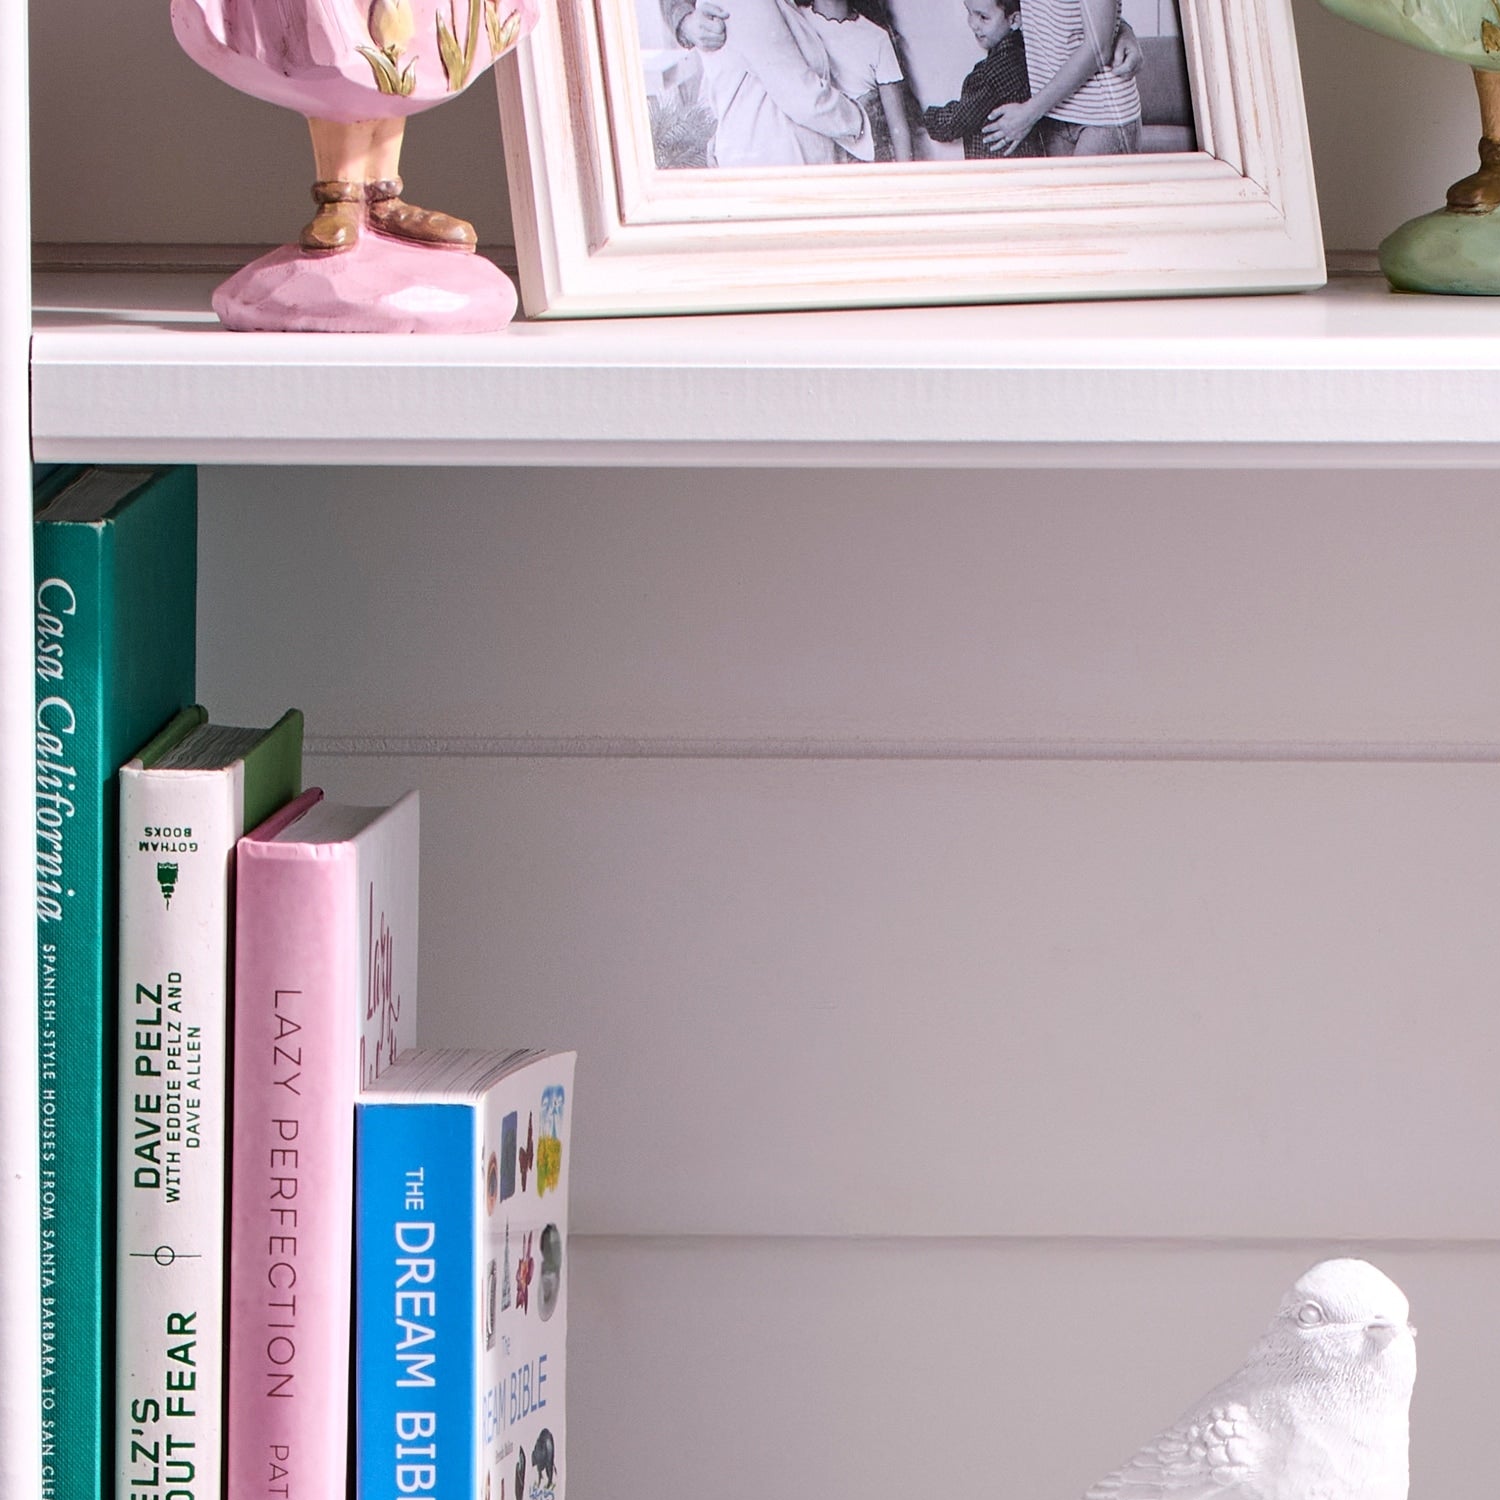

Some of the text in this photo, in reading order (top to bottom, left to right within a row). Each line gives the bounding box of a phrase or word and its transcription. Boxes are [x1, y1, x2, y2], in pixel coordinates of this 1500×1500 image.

[36, 578, 77, 923] Casa California
[139, 842, 198, 852] GOTHAM
[144, 827, 192, 838] BOOKS
[43, 944, 56, 1079] SPANISH-STYLE
[134, 983, 162, 1188] DAVE PELZ
[166, 972, 181, 1203] WITH EDDIE PELZ AND
[186, 1026, 201, 1148] DAVE ALLEN
[43, 1090, 56, 1161] HOUSES
[42, 1170, 56, 1220] FROM
[266, 990, 302, 1398] LAZY PERFECTION
[405, 1167, 424, 1210] THE
[42, 1230, 56, 1288] SANTA
[42, 1299, 56, 1378] BARBARA
[395, 1222, 436, 1387] DREAM
[42, 1387, 56, 1410] TO
[166, 1311, 197, 1417] FEAR
[510, 1354, 547, 1425] BIBLE
[42, 1420, 55, 1456] SAN
